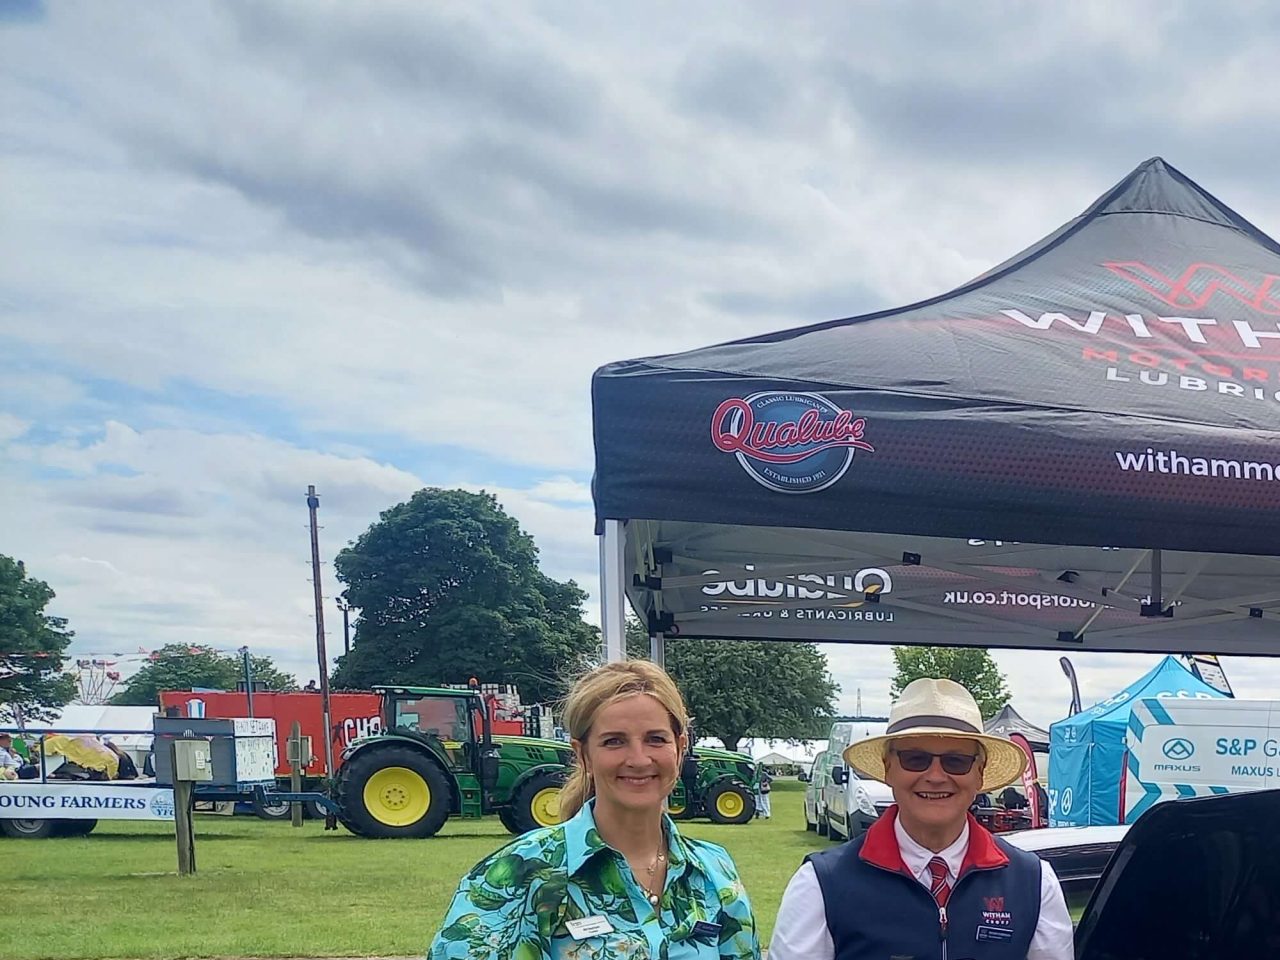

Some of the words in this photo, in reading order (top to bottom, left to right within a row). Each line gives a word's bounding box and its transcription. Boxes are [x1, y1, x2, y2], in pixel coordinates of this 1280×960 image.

[711, 398, 874, 464] Qualube
[763, 467, 812, 485] ESTABLISHED
[1215, 737, 1257, 757] S&P
[1154, 764, 1201, 772] MAXUS
[1231, 765, 1274, 777] MAXUS
[0, 795, 56, 809] OUNG
[61, 796, 146, 810] FARMERS
[982, 911, 1011, 919] WITHAM
